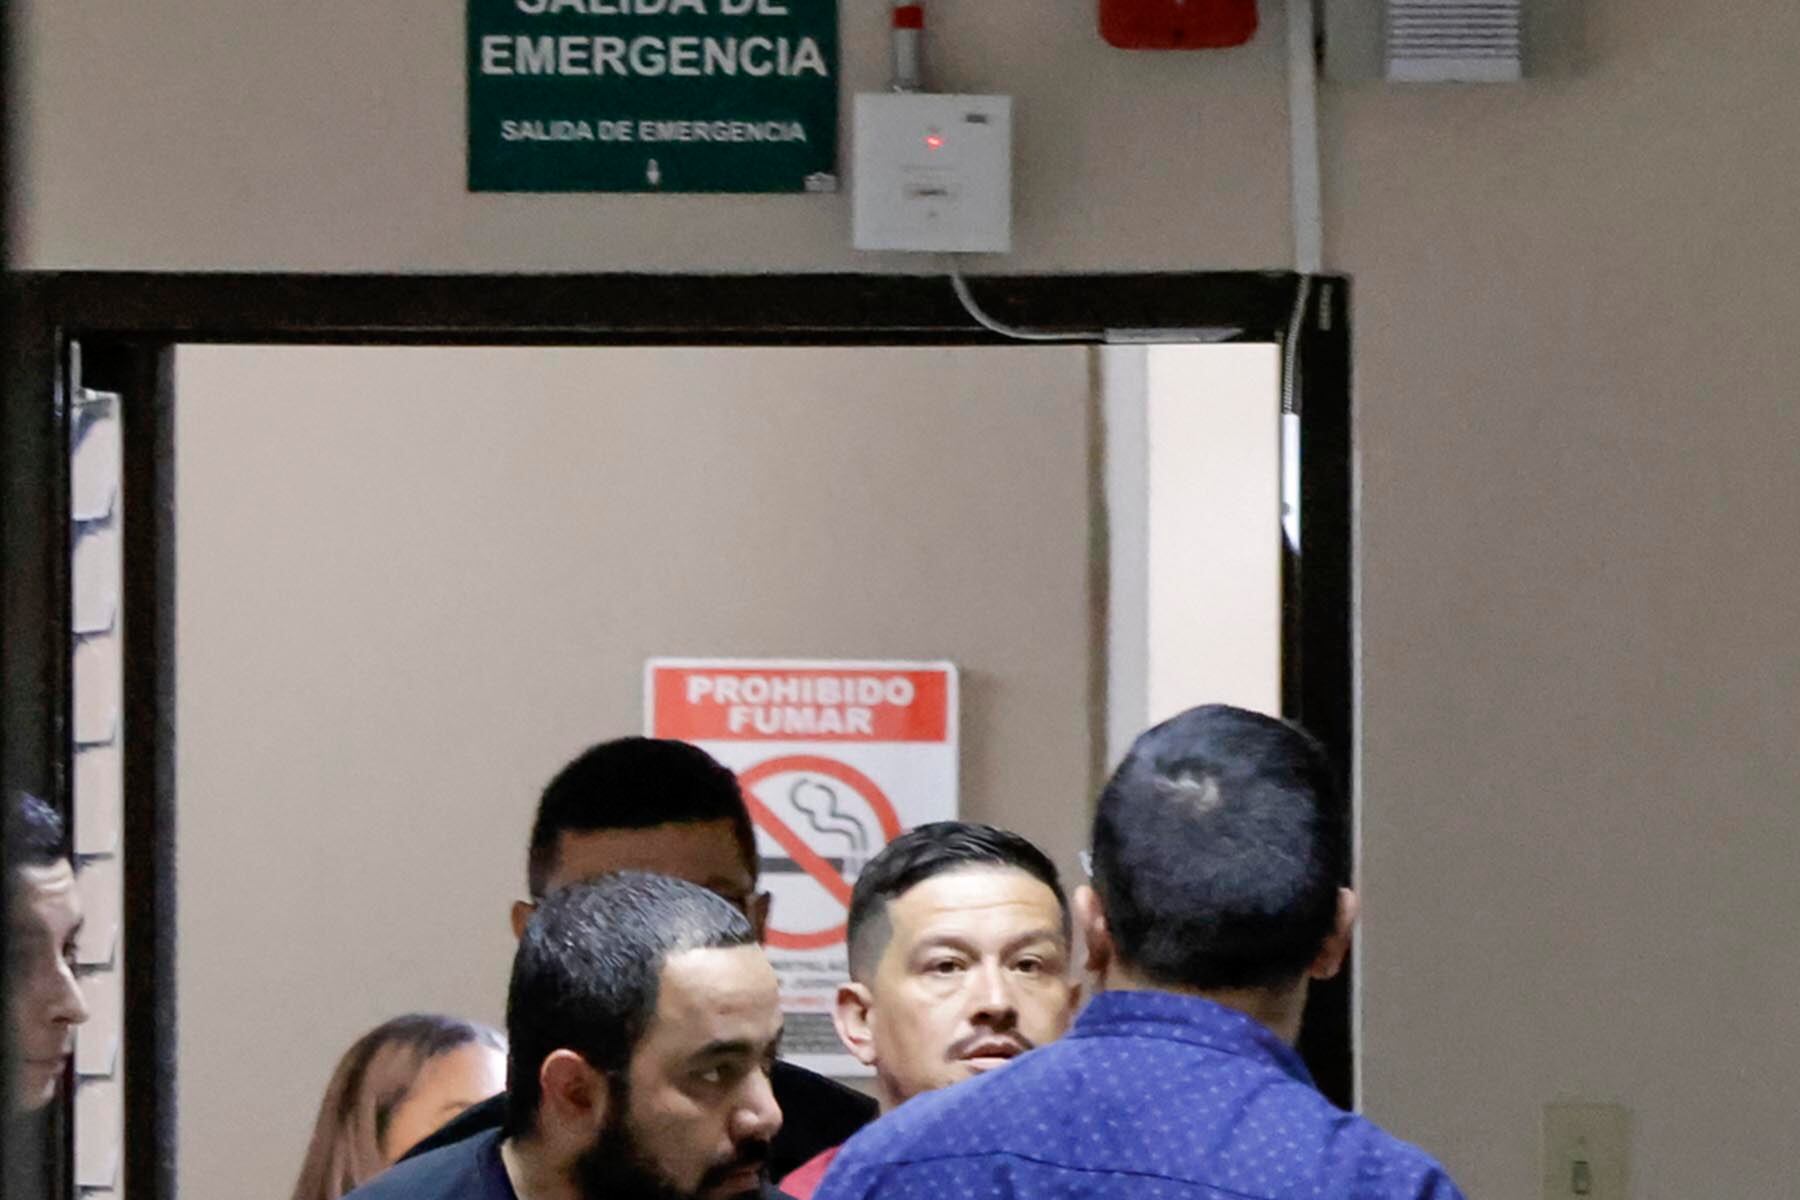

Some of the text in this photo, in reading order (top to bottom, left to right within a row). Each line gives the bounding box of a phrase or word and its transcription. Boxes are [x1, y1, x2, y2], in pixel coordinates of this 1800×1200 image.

[481, 35, 828, 77] EMERGENCIA
[501, 119, 807, 143] SALIDA DE EMERGENCIA
[686, 675, 915, 707] PROHIBIDO
[727, 704, 873, 735] FUMAR
